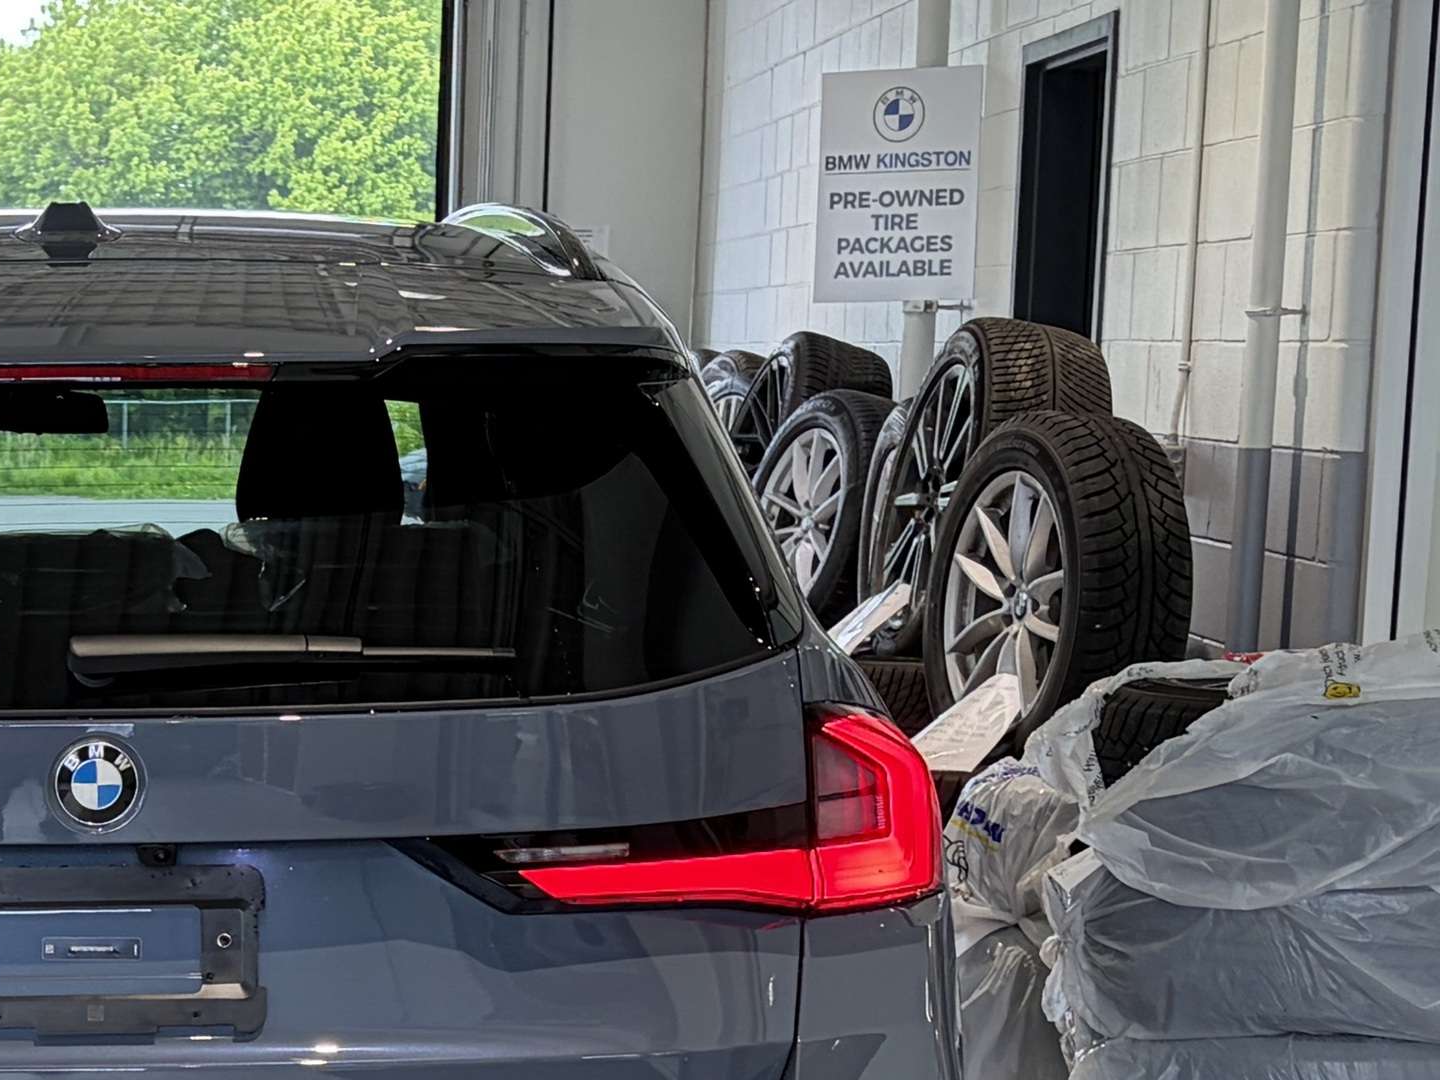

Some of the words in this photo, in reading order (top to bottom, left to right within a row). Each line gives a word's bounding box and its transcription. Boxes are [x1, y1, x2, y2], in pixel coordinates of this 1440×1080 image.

[880, 89, 918, 106] BMW
[825, 154, 870, 172] BMW
[876, 150, 971, 169] KINGSTON
[829, 188, 965, 210] PRE-OWNED
[871, 213, 918, 232] TIRE
[837, 235, 953, 255] PACKAGES
[834, 259, 953, 279] AVAILABLE
[63, 743, 132, 772] BMW
